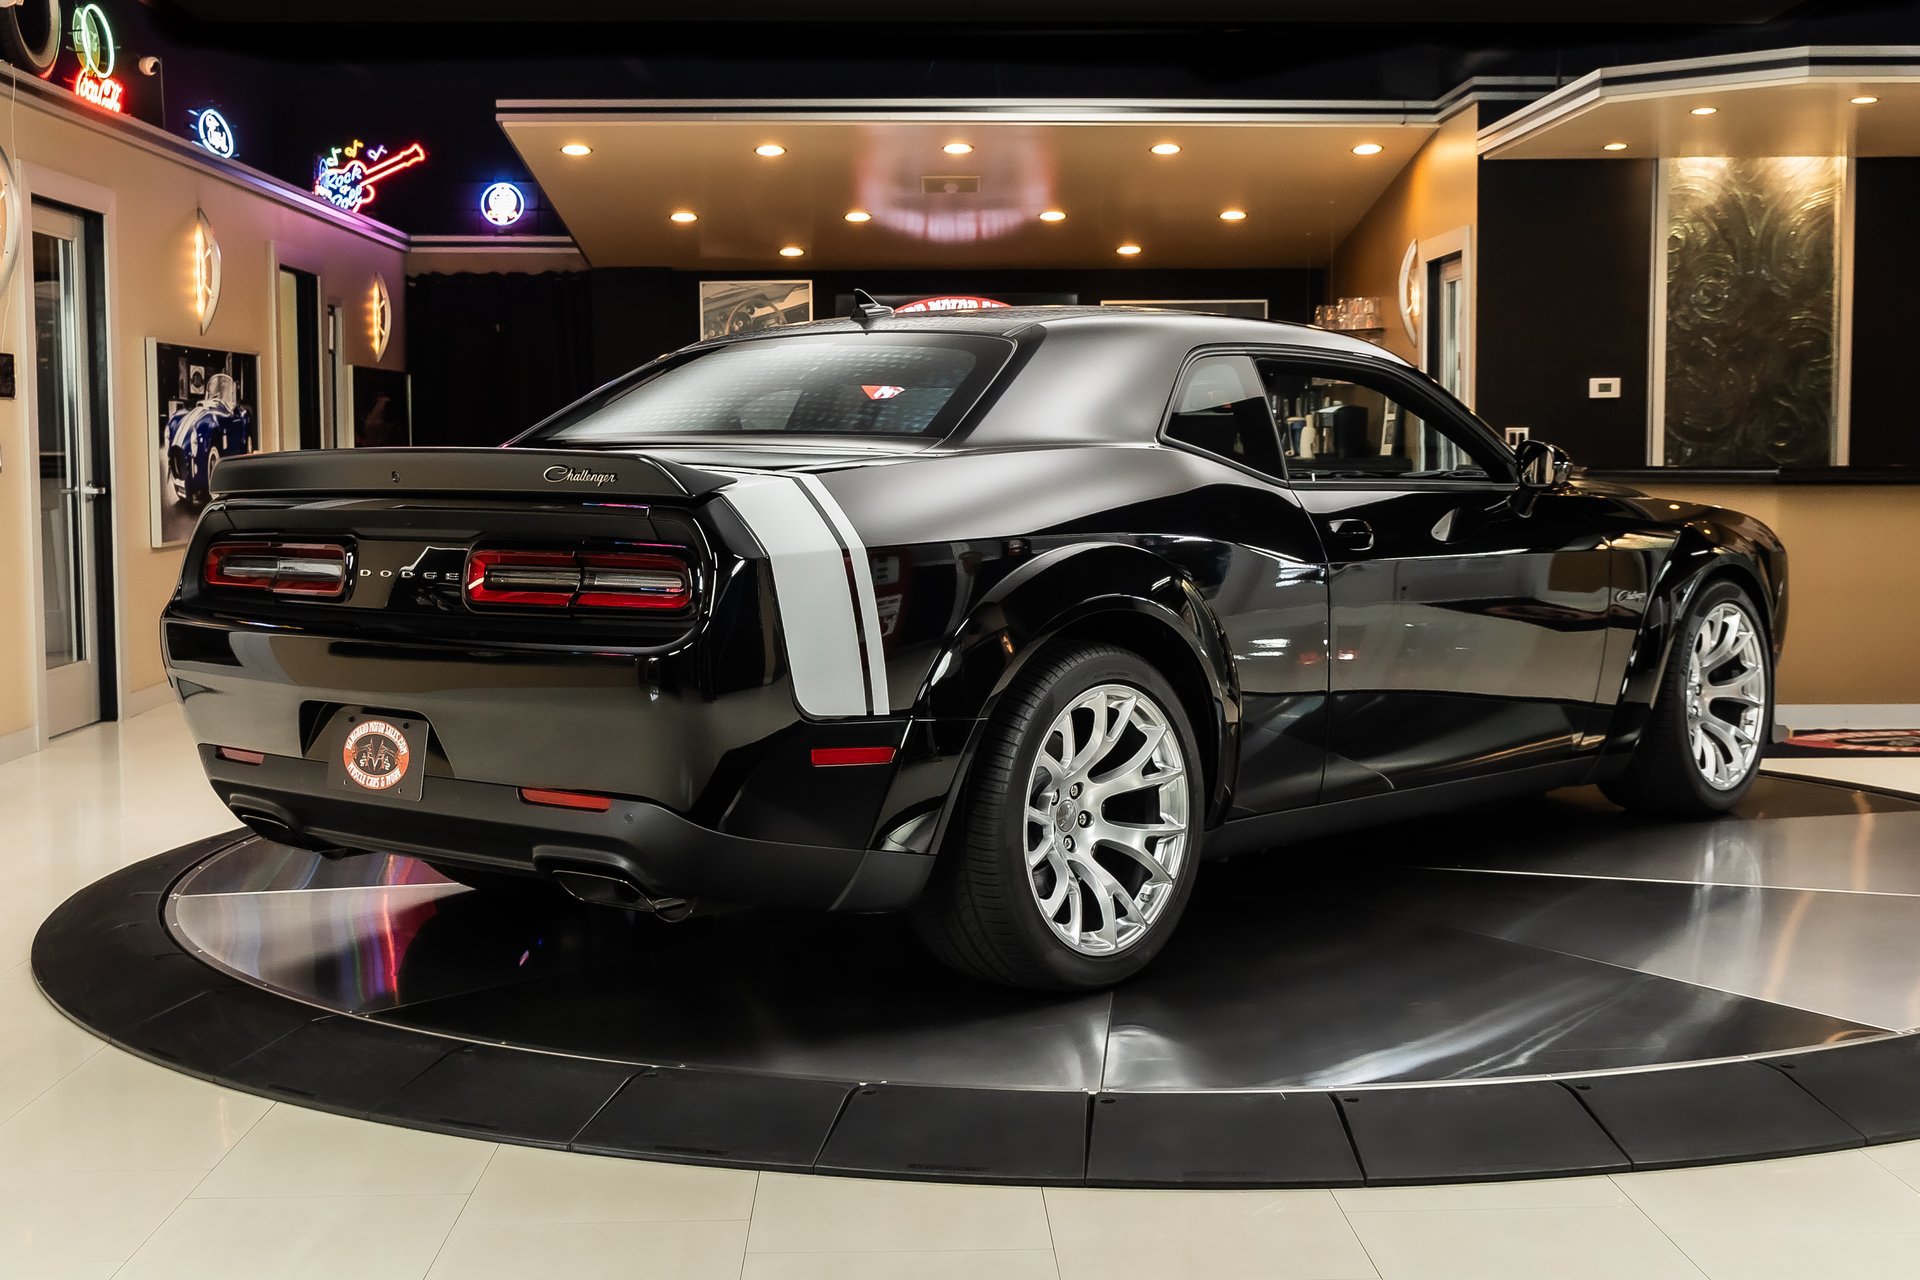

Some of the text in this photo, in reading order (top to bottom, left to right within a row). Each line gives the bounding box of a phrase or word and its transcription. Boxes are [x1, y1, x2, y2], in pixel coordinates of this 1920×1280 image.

[325, 164, 362, 189] Rock
[543, 465, 616, 487] Challenger
[360, 569, 460, 580] DODGE
[369, 721, 386, 734] MOTOR
[347, 761, 367, 785] MUSCLE
[366, 776, 380, 788] CARS
